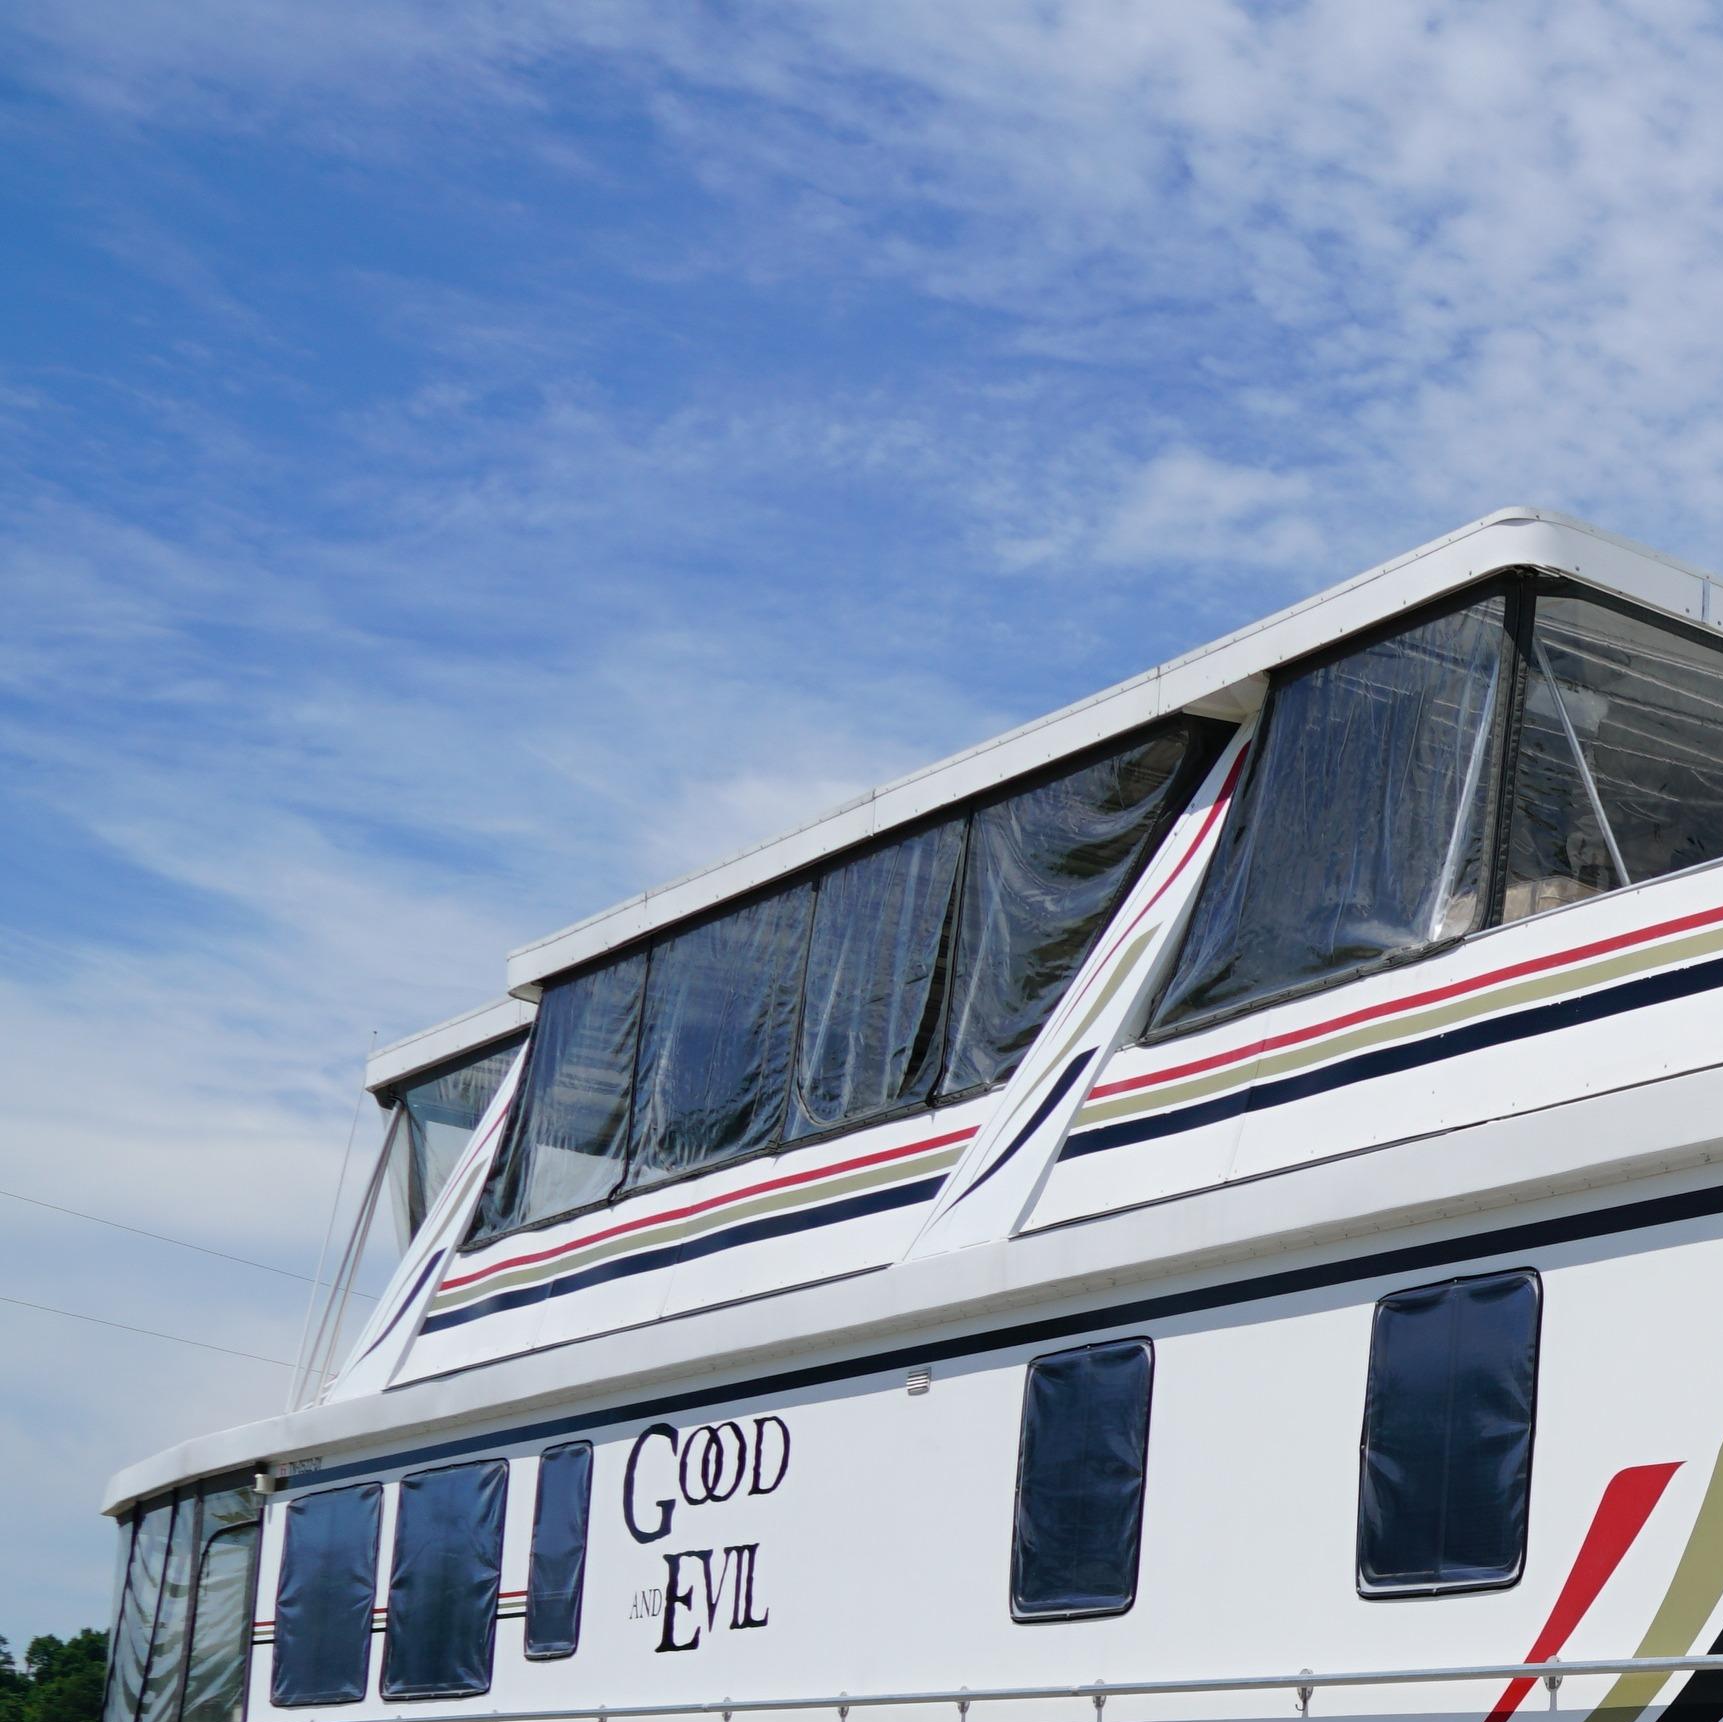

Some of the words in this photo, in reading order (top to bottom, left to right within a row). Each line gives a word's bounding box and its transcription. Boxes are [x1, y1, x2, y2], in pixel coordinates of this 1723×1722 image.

[623, 1415, 791, 1544] GOOD
[629, 1587, 662, 1620] AND
[655, 1542, 770, 1653] EVIL
